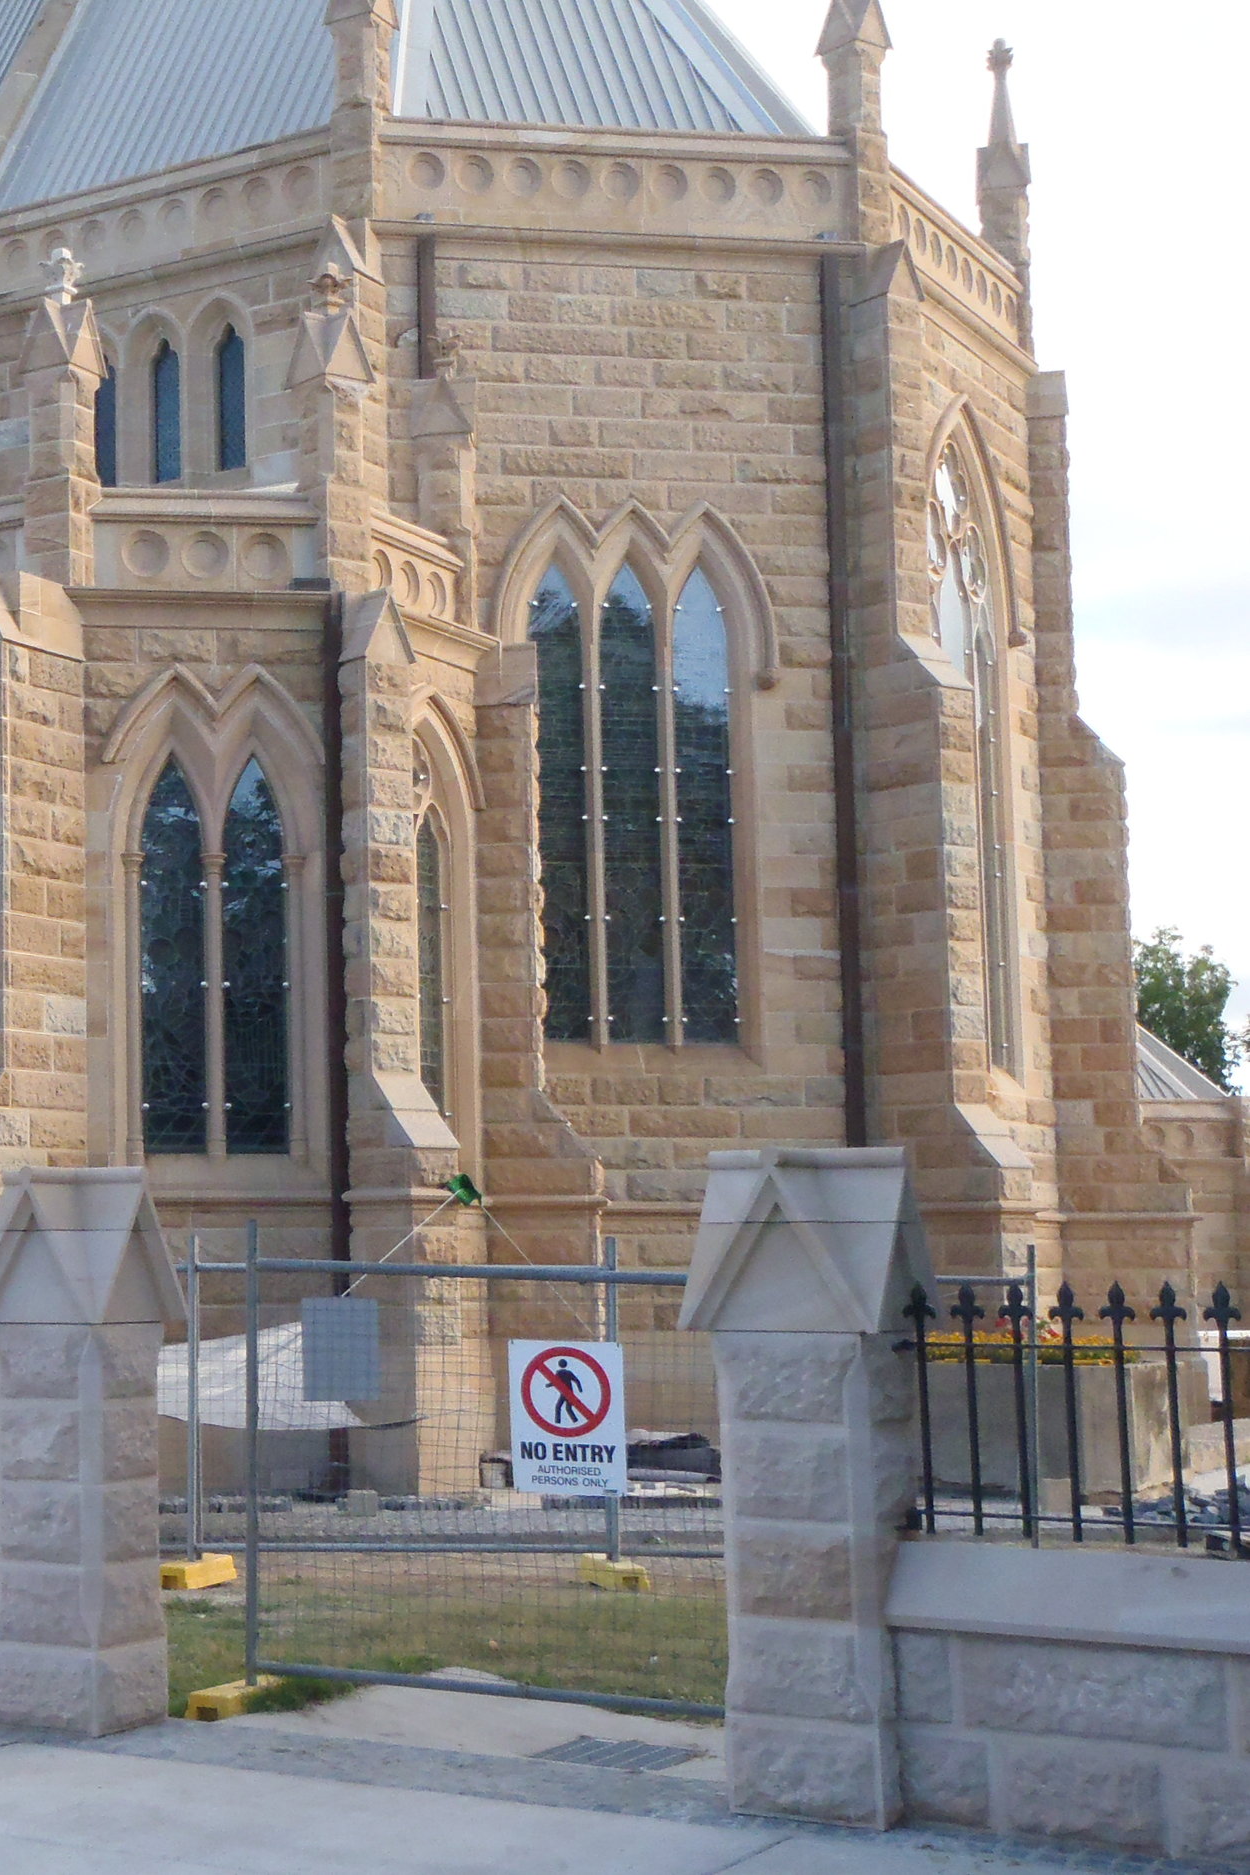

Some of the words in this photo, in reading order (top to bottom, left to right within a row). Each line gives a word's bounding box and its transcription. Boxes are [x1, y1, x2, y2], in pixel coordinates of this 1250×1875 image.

[520, 1441, 547, 1461] NO
[553, 1442, 615, 1463] ENTRY
[537, 1464, 601, 1476] AUTHORISED
[531, 1475, 579, 1486] PERSONS
[582, 1477, 609, 1488] ONLY
